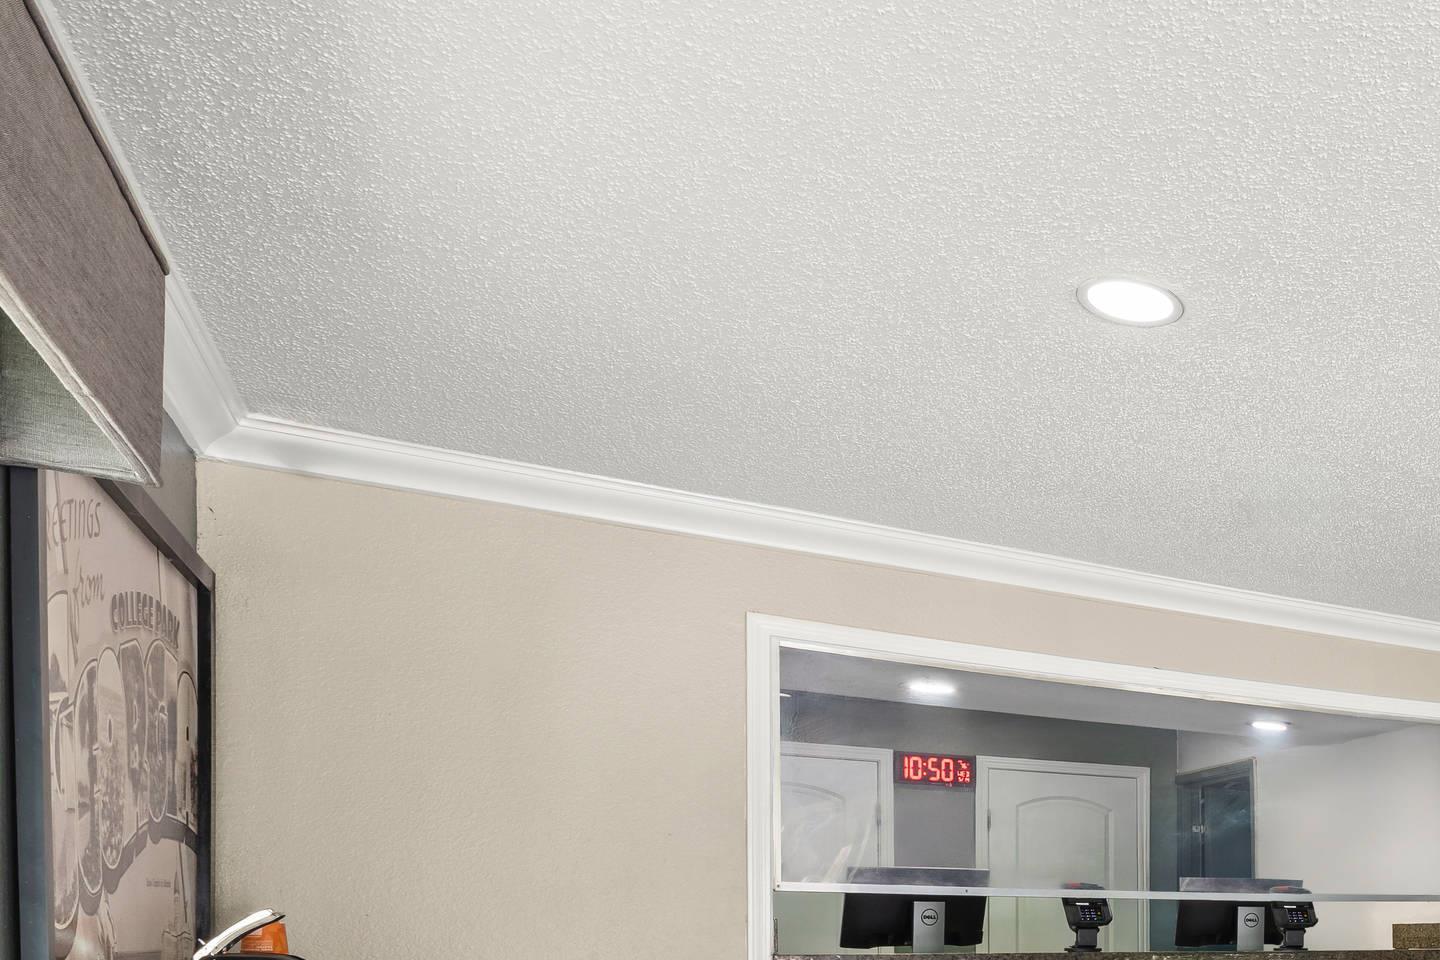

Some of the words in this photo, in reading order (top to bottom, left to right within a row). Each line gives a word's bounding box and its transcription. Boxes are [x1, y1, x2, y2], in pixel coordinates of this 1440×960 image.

[70, 549, 105, 664] from
[110, 590, 154, 633] COLLEGE
[154, 599, 181, 650] PARK
[903, 756, 954, 782] 10:50
